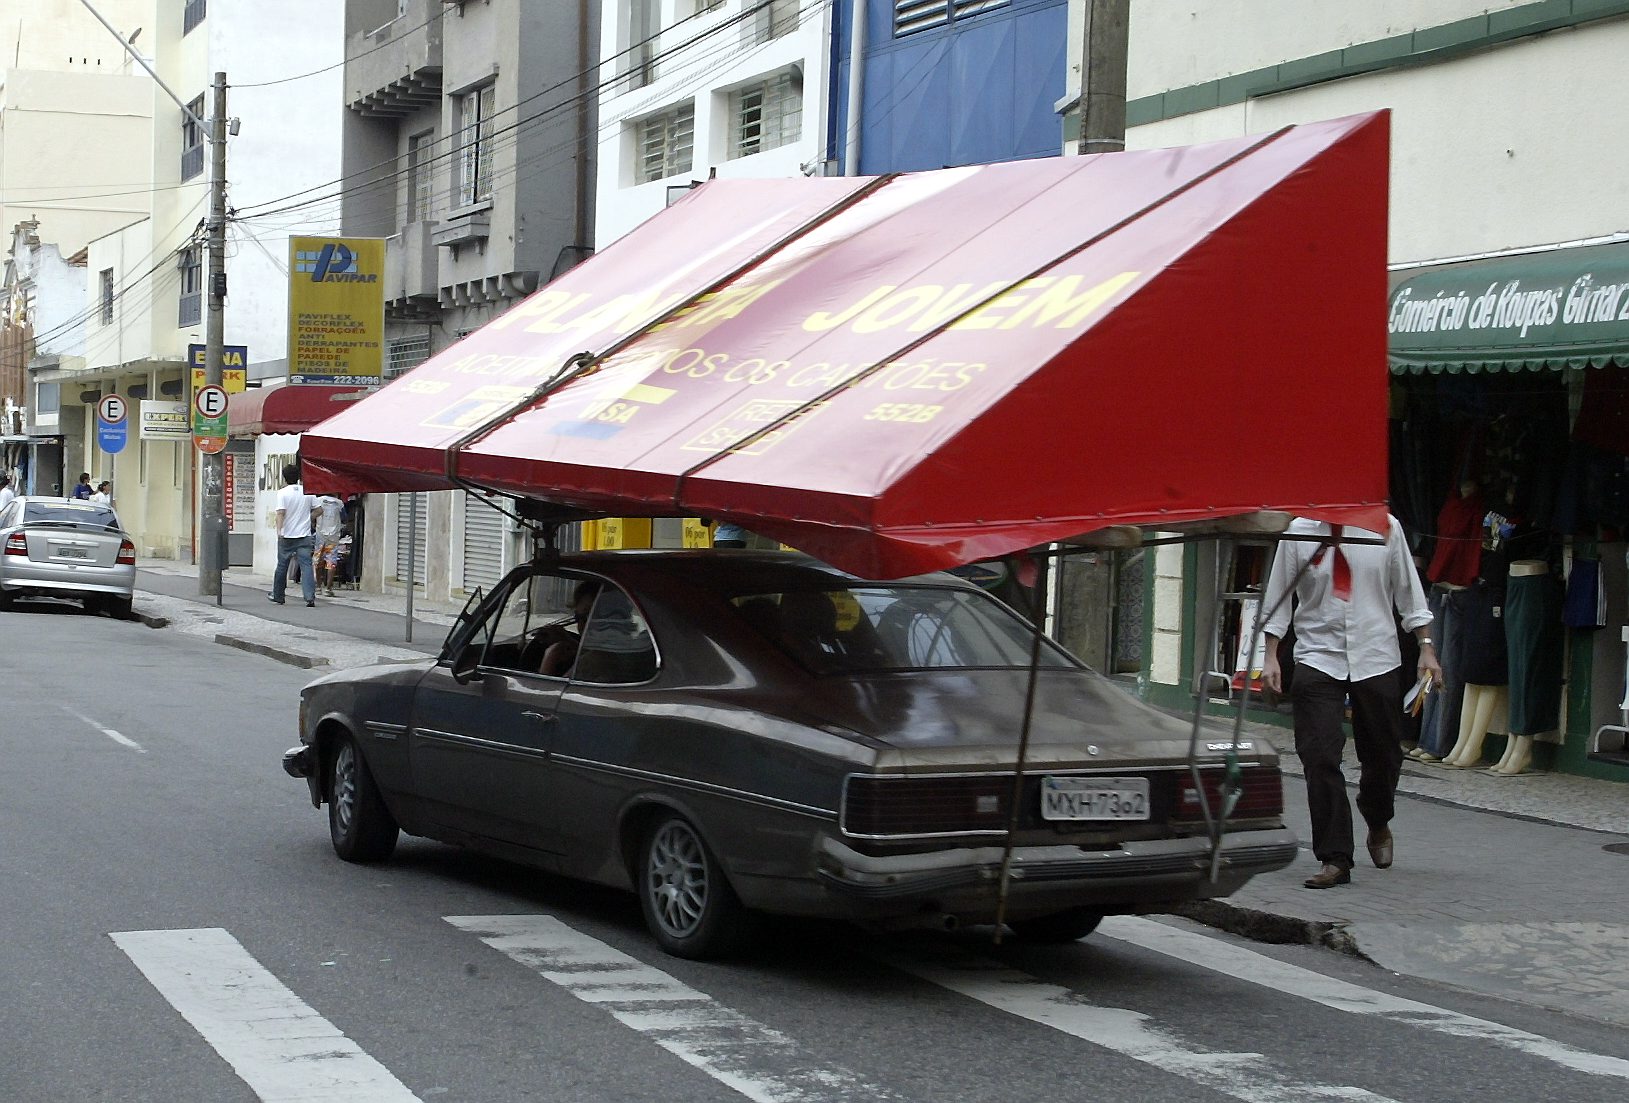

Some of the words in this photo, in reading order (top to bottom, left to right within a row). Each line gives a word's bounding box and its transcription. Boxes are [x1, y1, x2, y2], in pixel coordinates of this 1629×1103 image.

[312, 243, 377, 283] PAVIPAR
[802, 271, 1142, 333] JOVEM
[1388, 288, 1470, 333] Comércio
[1468, 281, 1498, 330] de
[1492, 279, 1564, 338] Roupas
[298, 313, 352, 321] PAVIFLEX
[298, 320, 364, 328] DECORFLEX
[297, 353, 342, 361] PAREDE
[195, 371, 241, 381] PRK
[333, 375, 379, 385] 222-2096
[724, 359, 792, 385] OS
[108, 400, 118, 418] E
[206, 391, 218, 412] E
